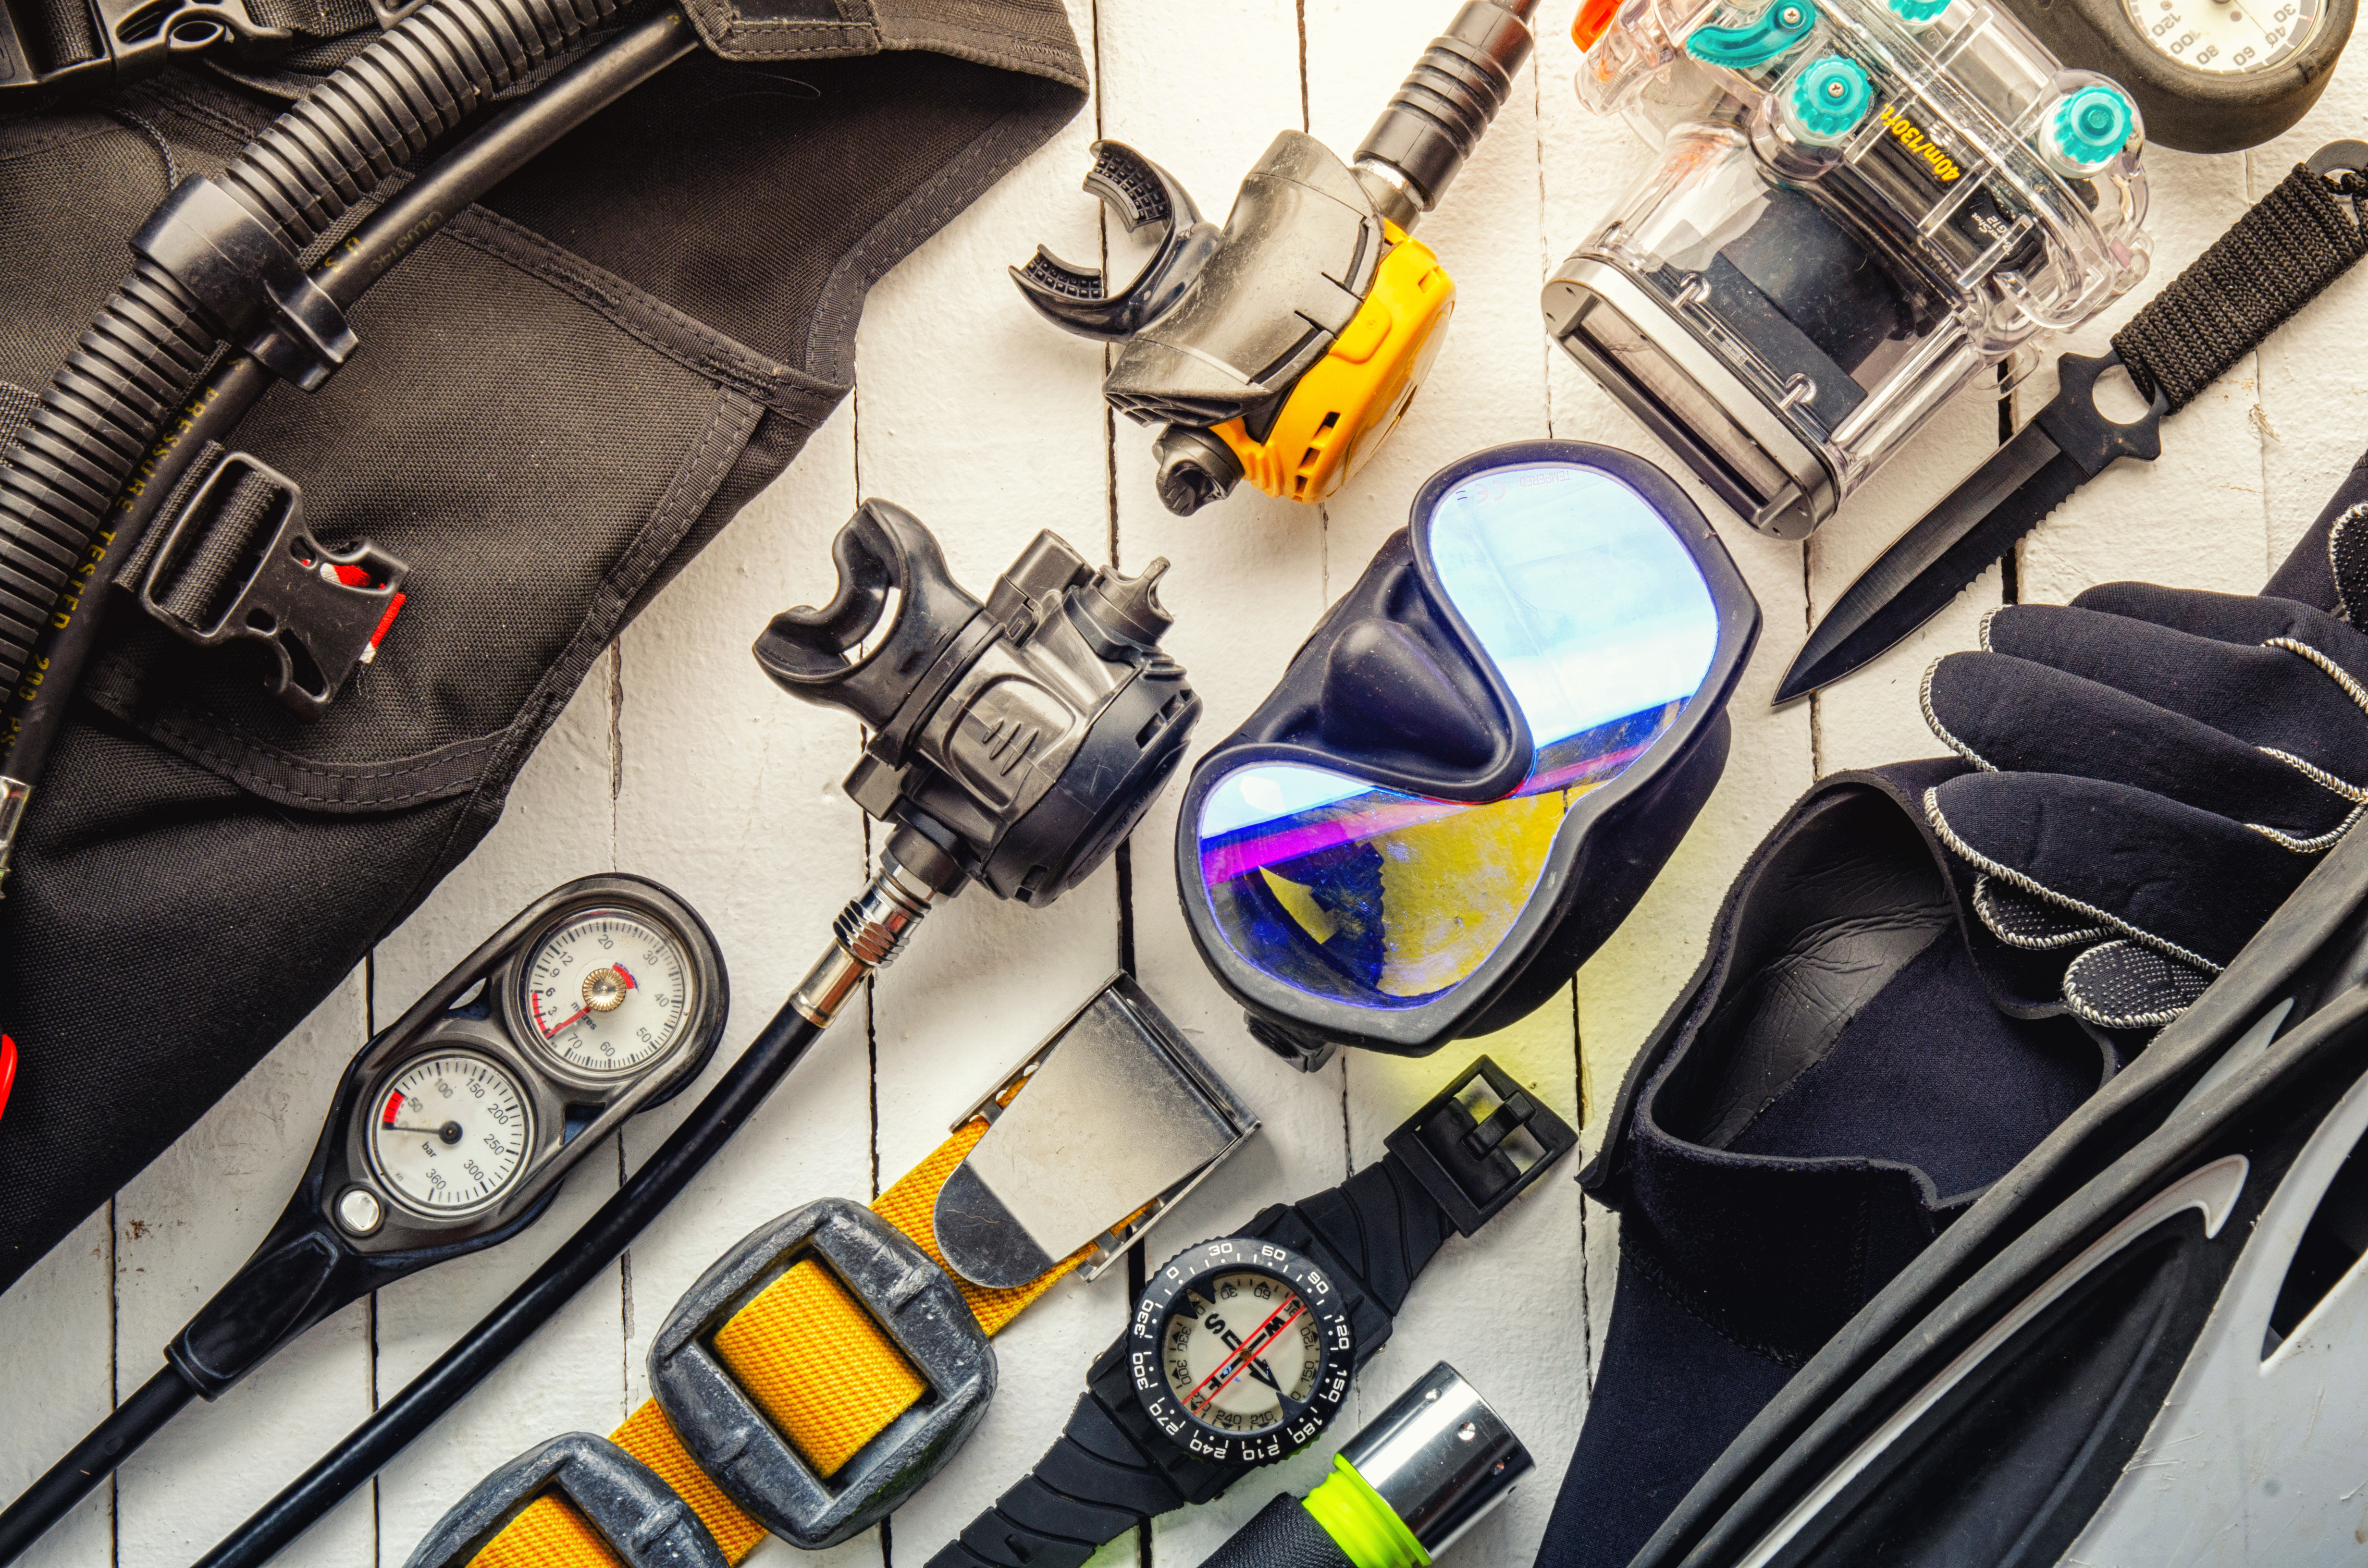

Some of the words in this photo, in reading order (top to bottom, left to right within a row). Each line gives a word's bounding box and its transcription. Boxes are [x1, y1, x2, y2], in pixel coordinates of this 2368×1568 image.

[2274, 3, 2296, 23] 30
[2152, 13, 2181, 37] 120
[2265, 25, 2286, 45] 40
[2170, 30, 2201, 54] 100
[2196, 45, 2220, 65] 80
[2233, 46, 2256, 66] 60
[1986, 215, 2007, 233] G12
[115, 386, 219, 513] PRESSURE
[1519, 470, 1571, 487] TEMPERED
[51, 530, 117, 629] TESTED
[18, 653, 49, 701] 200
[598, 934, 613, 950] 20
[559, 951, 573, 967] 12
[643, 950, 658, 966] 30
[550, 968, 560, 978] 9
[545, 987, 555, 997] 6
[654, 992, 669, 1007] 40
[570, 1001, 597, 1030] mtres
[567, 1032, 583, 1049] 70
[636, 1027, 652, 1042] 50
[600, 1041, 616, 1057] 60
[433, 1078, 454, 1099] 100
[466, 1078, 485, 1098] 150
[408, 1097, 423, 1113] 50
[487, 1103, 508, 1125] 200
[421, 1141, 437, 1158] bar
[483, 1134, 505, 1155] 250
[426, 1168, 446, 1190] 360
[463, 1159, 484, 1181] 300
[1209, 1243, 1233, 1256] 30
[1261, 1245, 1286, 1261] 60
[1166, 1266, 1179, 1279] 0
[1307, 1271, 1329, 1294] 90
[1221, 1287, 1238, 1299] 30
[1254, 1287, 1271, 1299] 60
[1135, 1299, 1154, 1336] 330
[1204, 1313, 1226, 1335] S
[1264, 1316, 1286, 1337] W
[1177, 1326, 1192, 1352] 330
[1300, 1327, 1314, 1350] 120
[1335, 1315, 1349, 1349] 120
[1133, 1352, 1149, 1390] 300
[1177, 1360, 1192, 1385] 300
[1300, 1360, 1315, 1383] 150
[1329, 1370, 1347, 1403] 150
[1149, 1403, 1179, 1435] 270
[1215, 1410, 1242, 1425] 240
[1250, 1411, 1274, 1425] 210
[1293, 1417, 1322, 1444] 180
[1189, 1439, 1226, 1459] 240
[1243, 1444, 1280, 1460] 210
